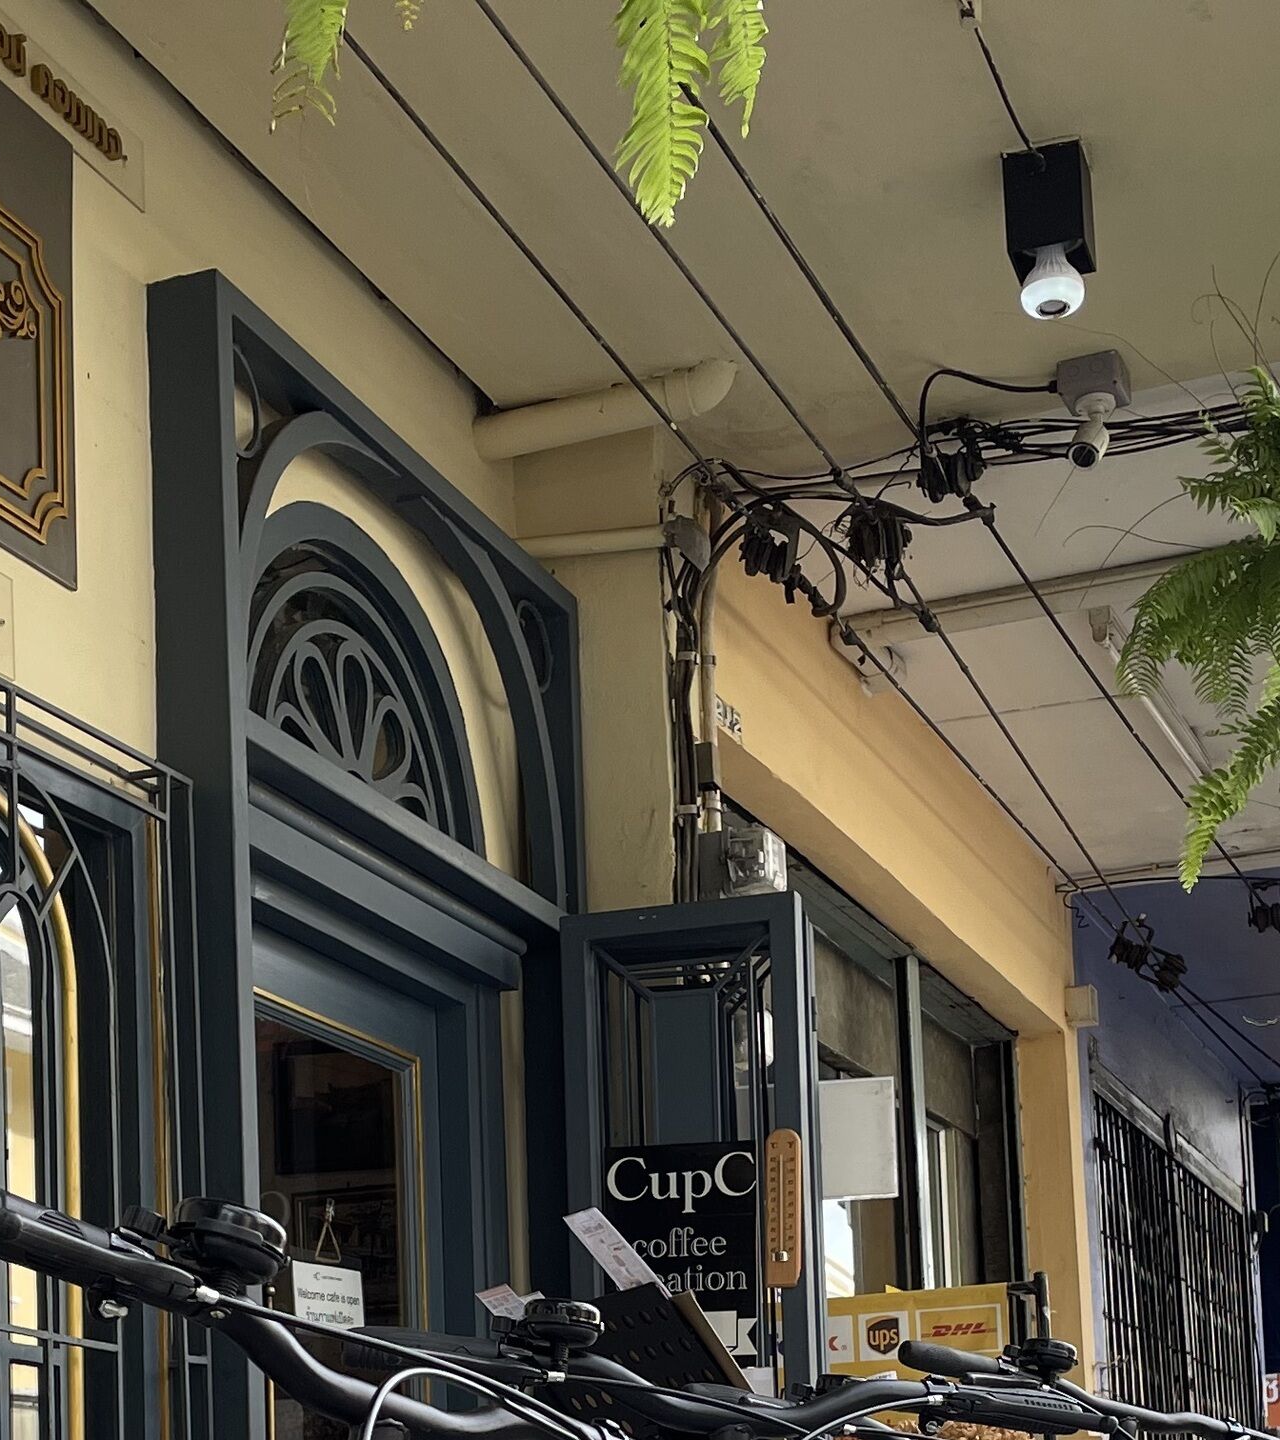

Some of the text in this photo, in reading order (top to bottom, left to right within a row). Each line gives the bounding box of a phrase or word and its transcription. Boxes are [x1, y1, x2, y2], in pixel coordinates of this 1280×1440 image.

[607, 1151, 757, 1214] CupC
[632, 1226, 728, 1258] coffee
[660, 1264, 748, 1292] ation
[869, 1328, 898, 1351] ups
[931, 1322, 987, 1338] DHL
